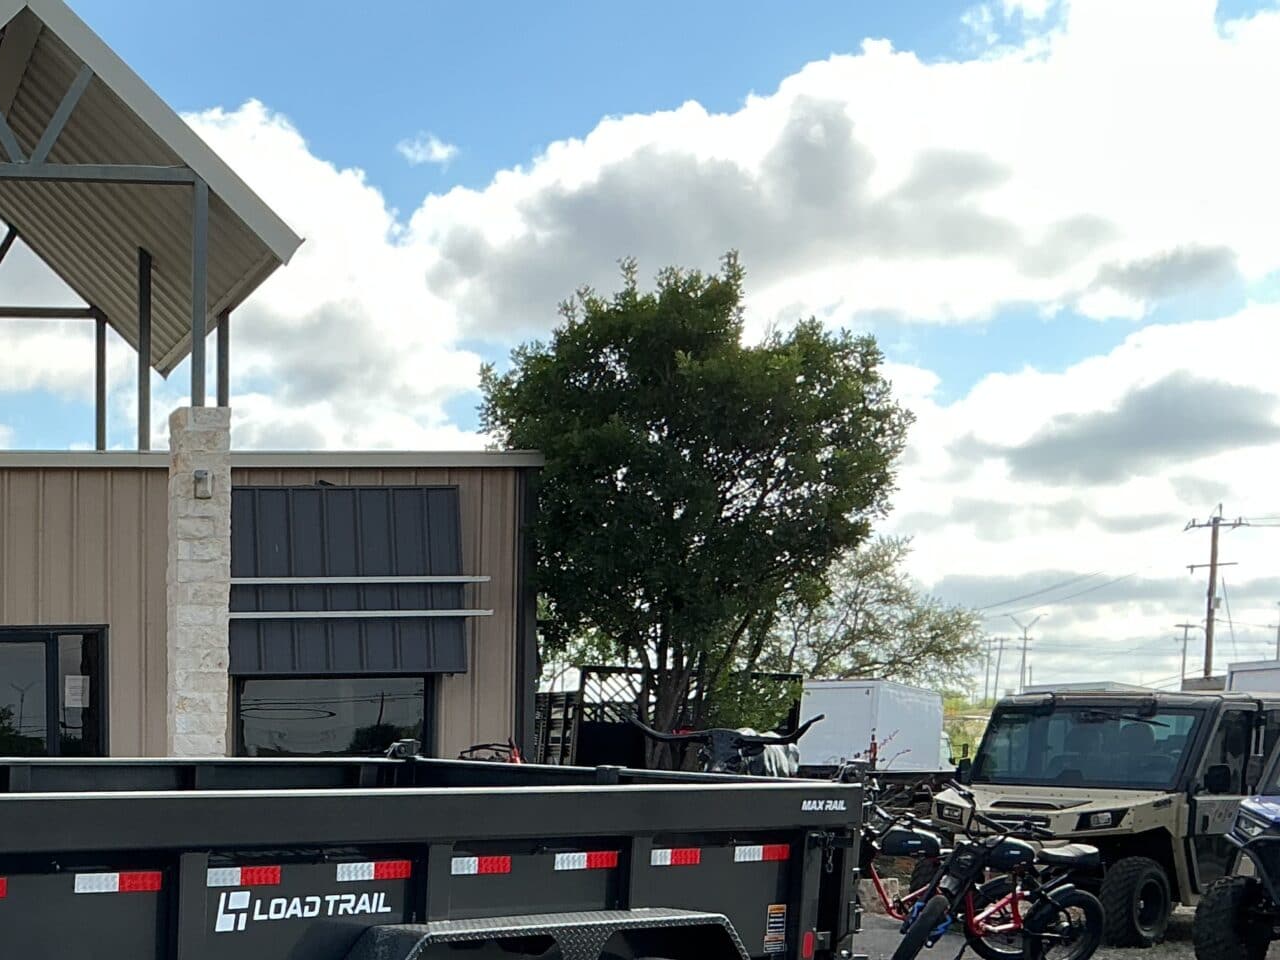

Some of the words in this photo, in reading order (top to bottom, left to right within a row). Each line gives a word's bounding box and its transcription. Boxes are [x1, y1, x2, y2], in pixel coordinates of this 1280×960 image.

[801, 799, 825, 811] MAX
[825, 799, 847, 811] RAIL
[253, 896, 320, 920] LOAD
[325, 892, 392, 916] TRAIL
